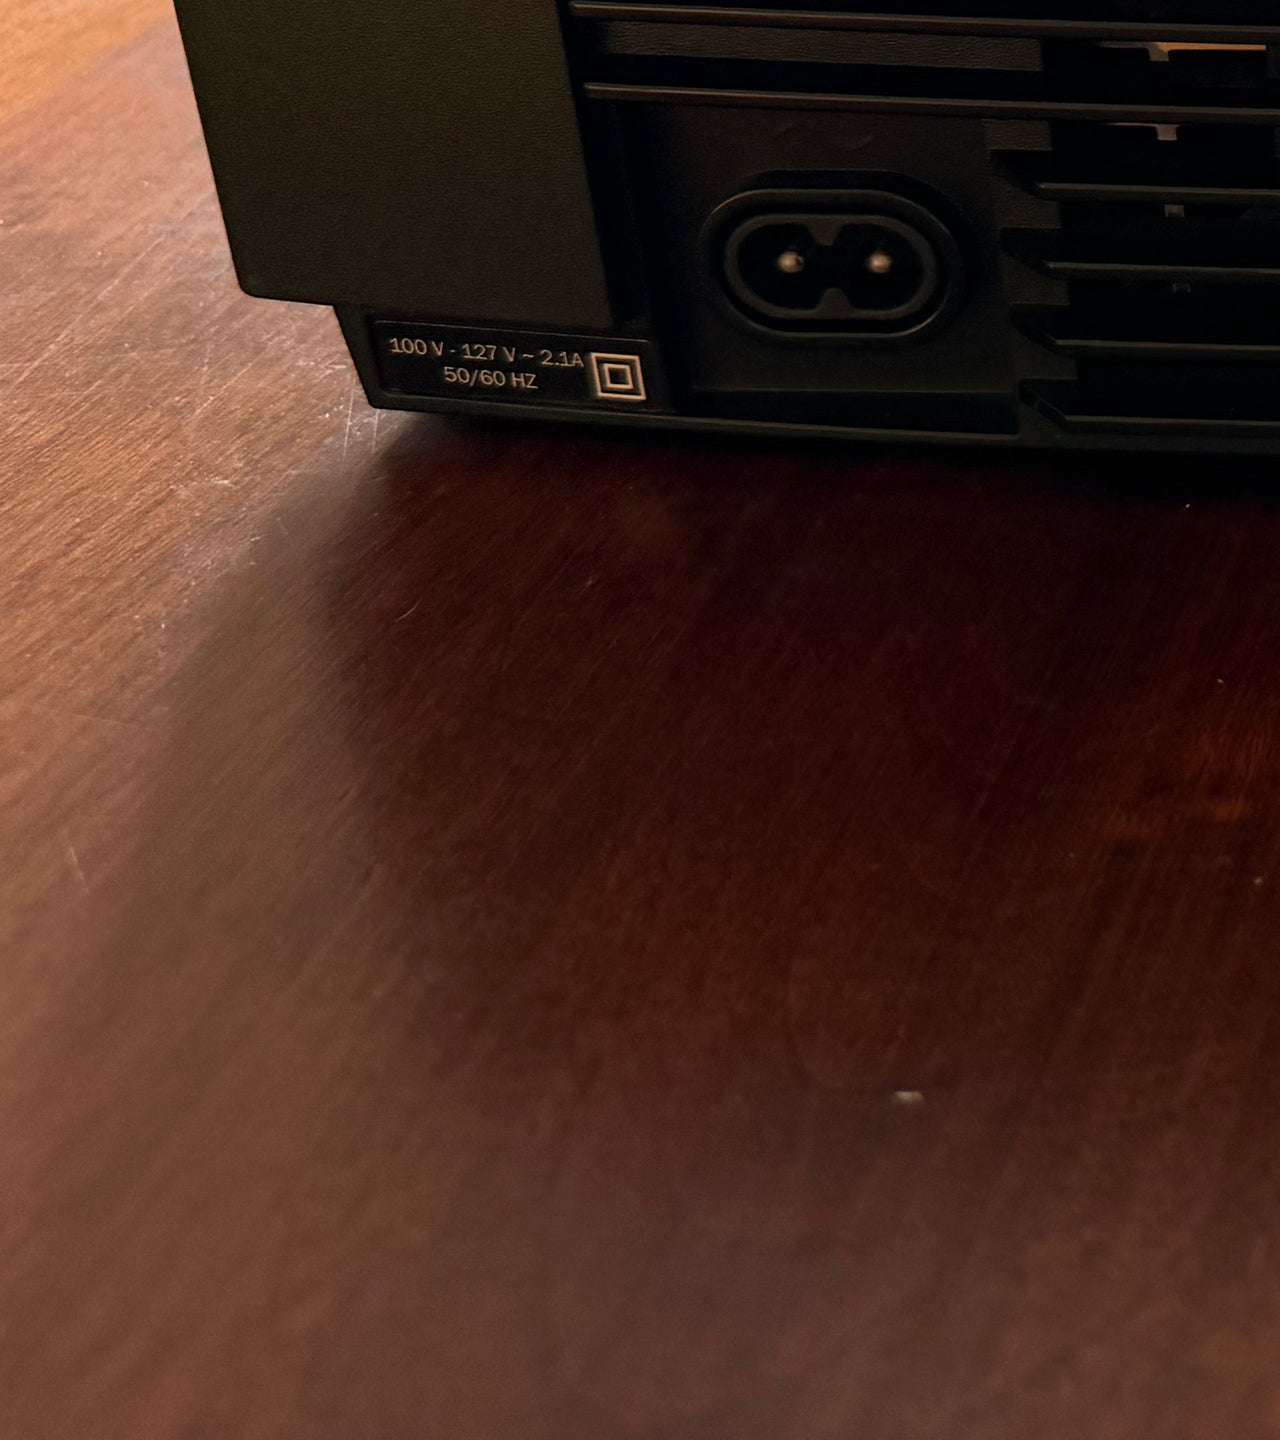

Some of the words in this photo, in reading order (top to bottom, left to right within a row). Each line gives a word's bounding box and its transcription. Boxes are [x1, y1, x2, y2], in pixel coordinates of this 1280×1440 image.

[388, 337, 428, 357] 100
[431, 341, 445, 358] V
[461, 343, 498, 362] 127
[503, 346, 517, 363] V
[443, 365, 507, 389] 50/60
[511, 371, 539, 390] HZ
